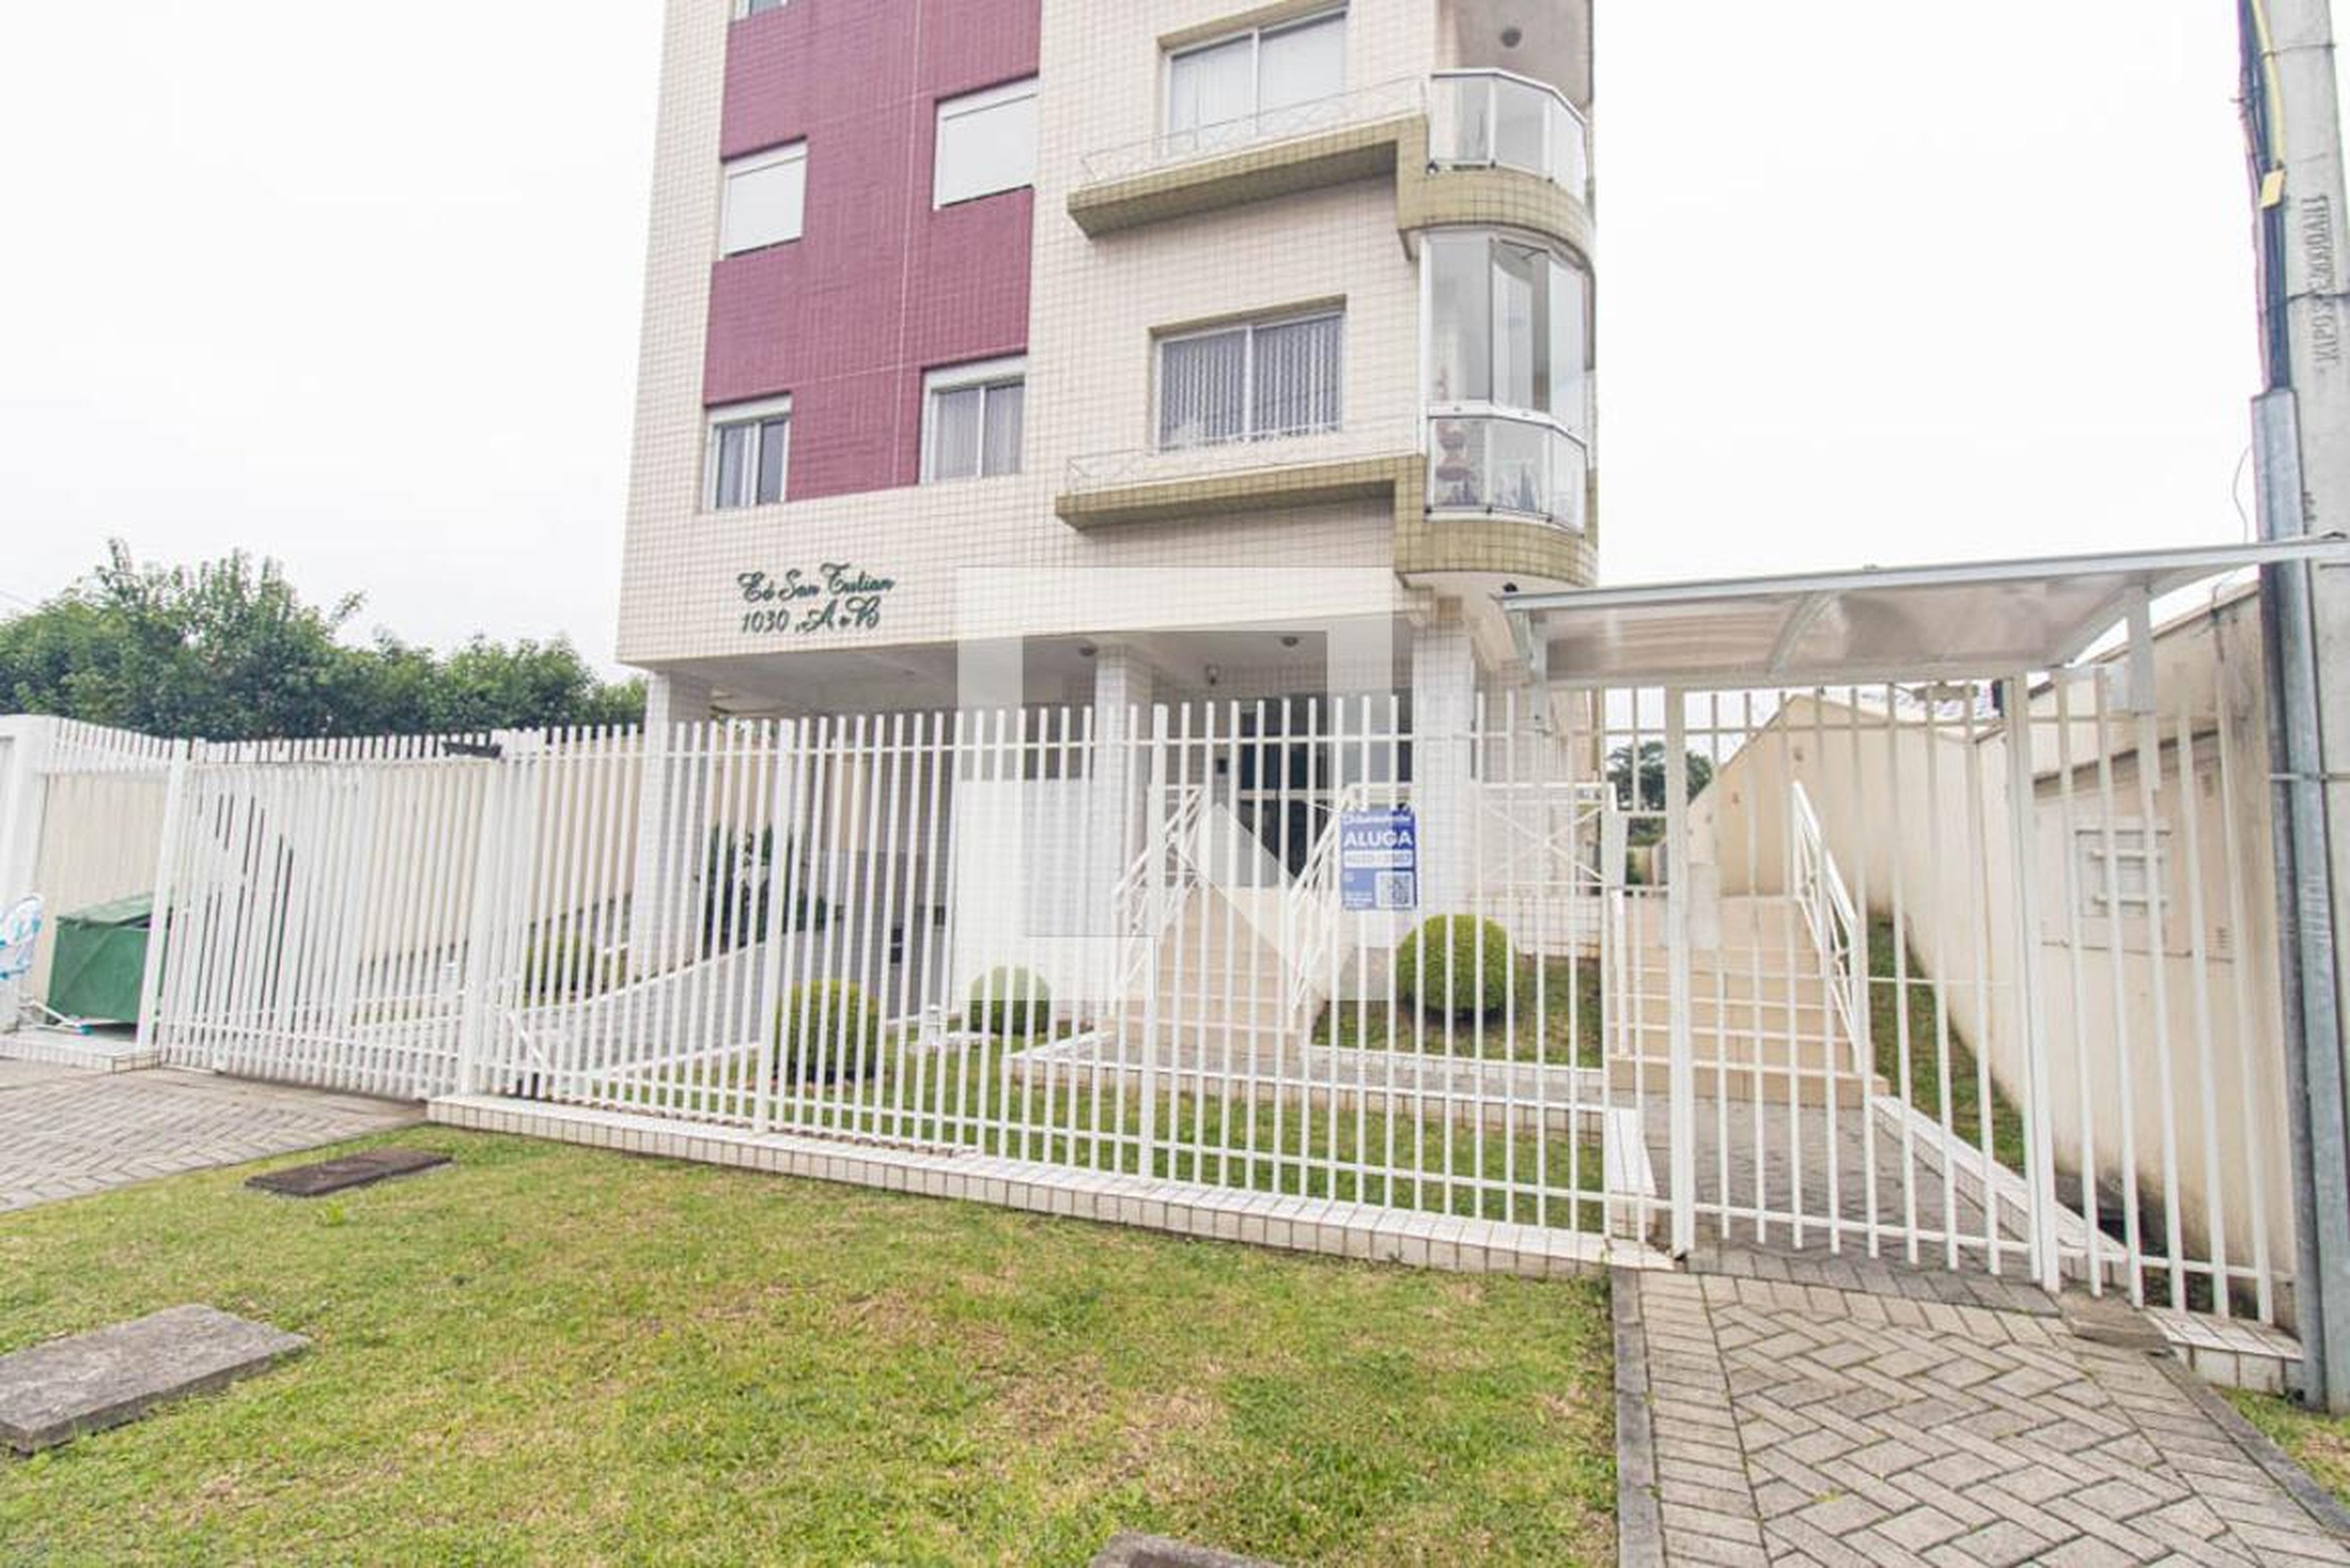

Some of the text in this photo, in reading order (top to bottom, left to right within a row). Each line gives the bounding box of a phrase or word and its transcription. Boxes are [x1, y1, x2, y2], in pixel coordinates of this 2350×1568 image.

[777, 568, 821, 602] San
[742, 609, 789, 633] 1030
[1344, 830, 1413, 847] ALUGA
